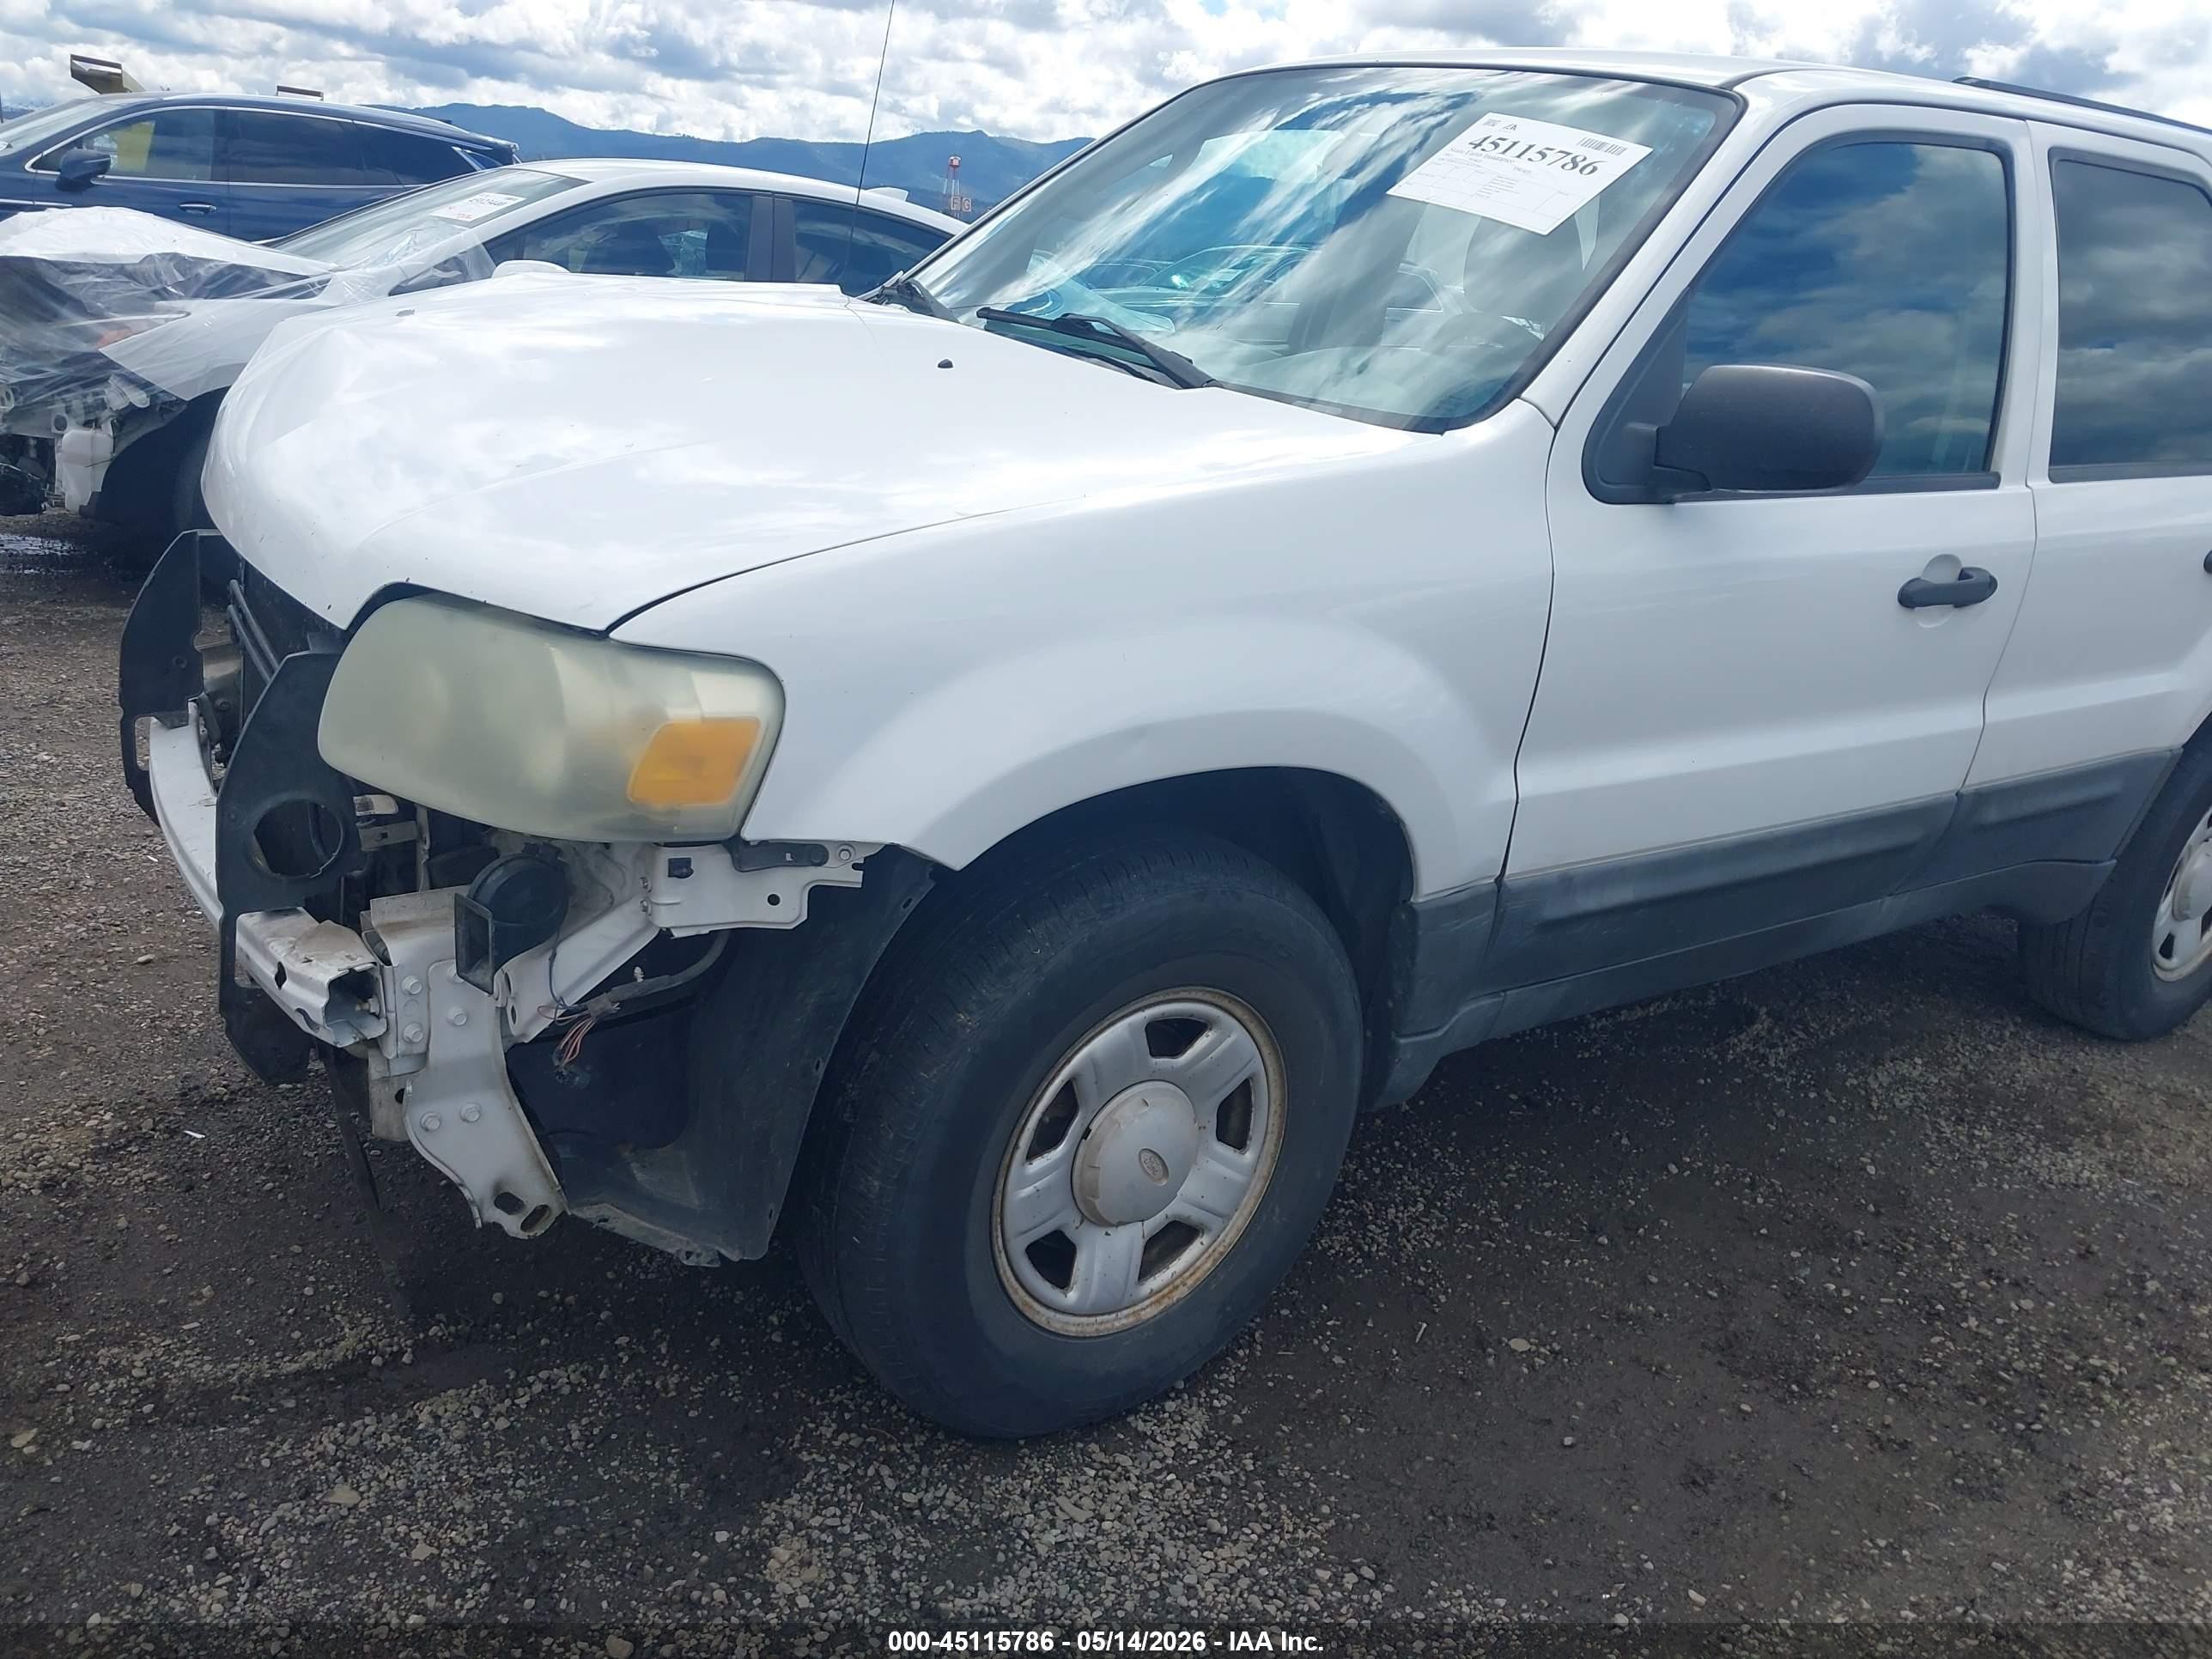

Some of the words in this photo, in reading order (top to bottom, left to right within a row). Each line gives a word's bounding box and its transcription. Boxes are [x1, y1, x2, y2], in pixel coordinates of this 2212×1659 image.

[1468, 135, 1607, 176] 45115786
[952, 198, 960, 209] F
[963, 198, 970, 210] G
